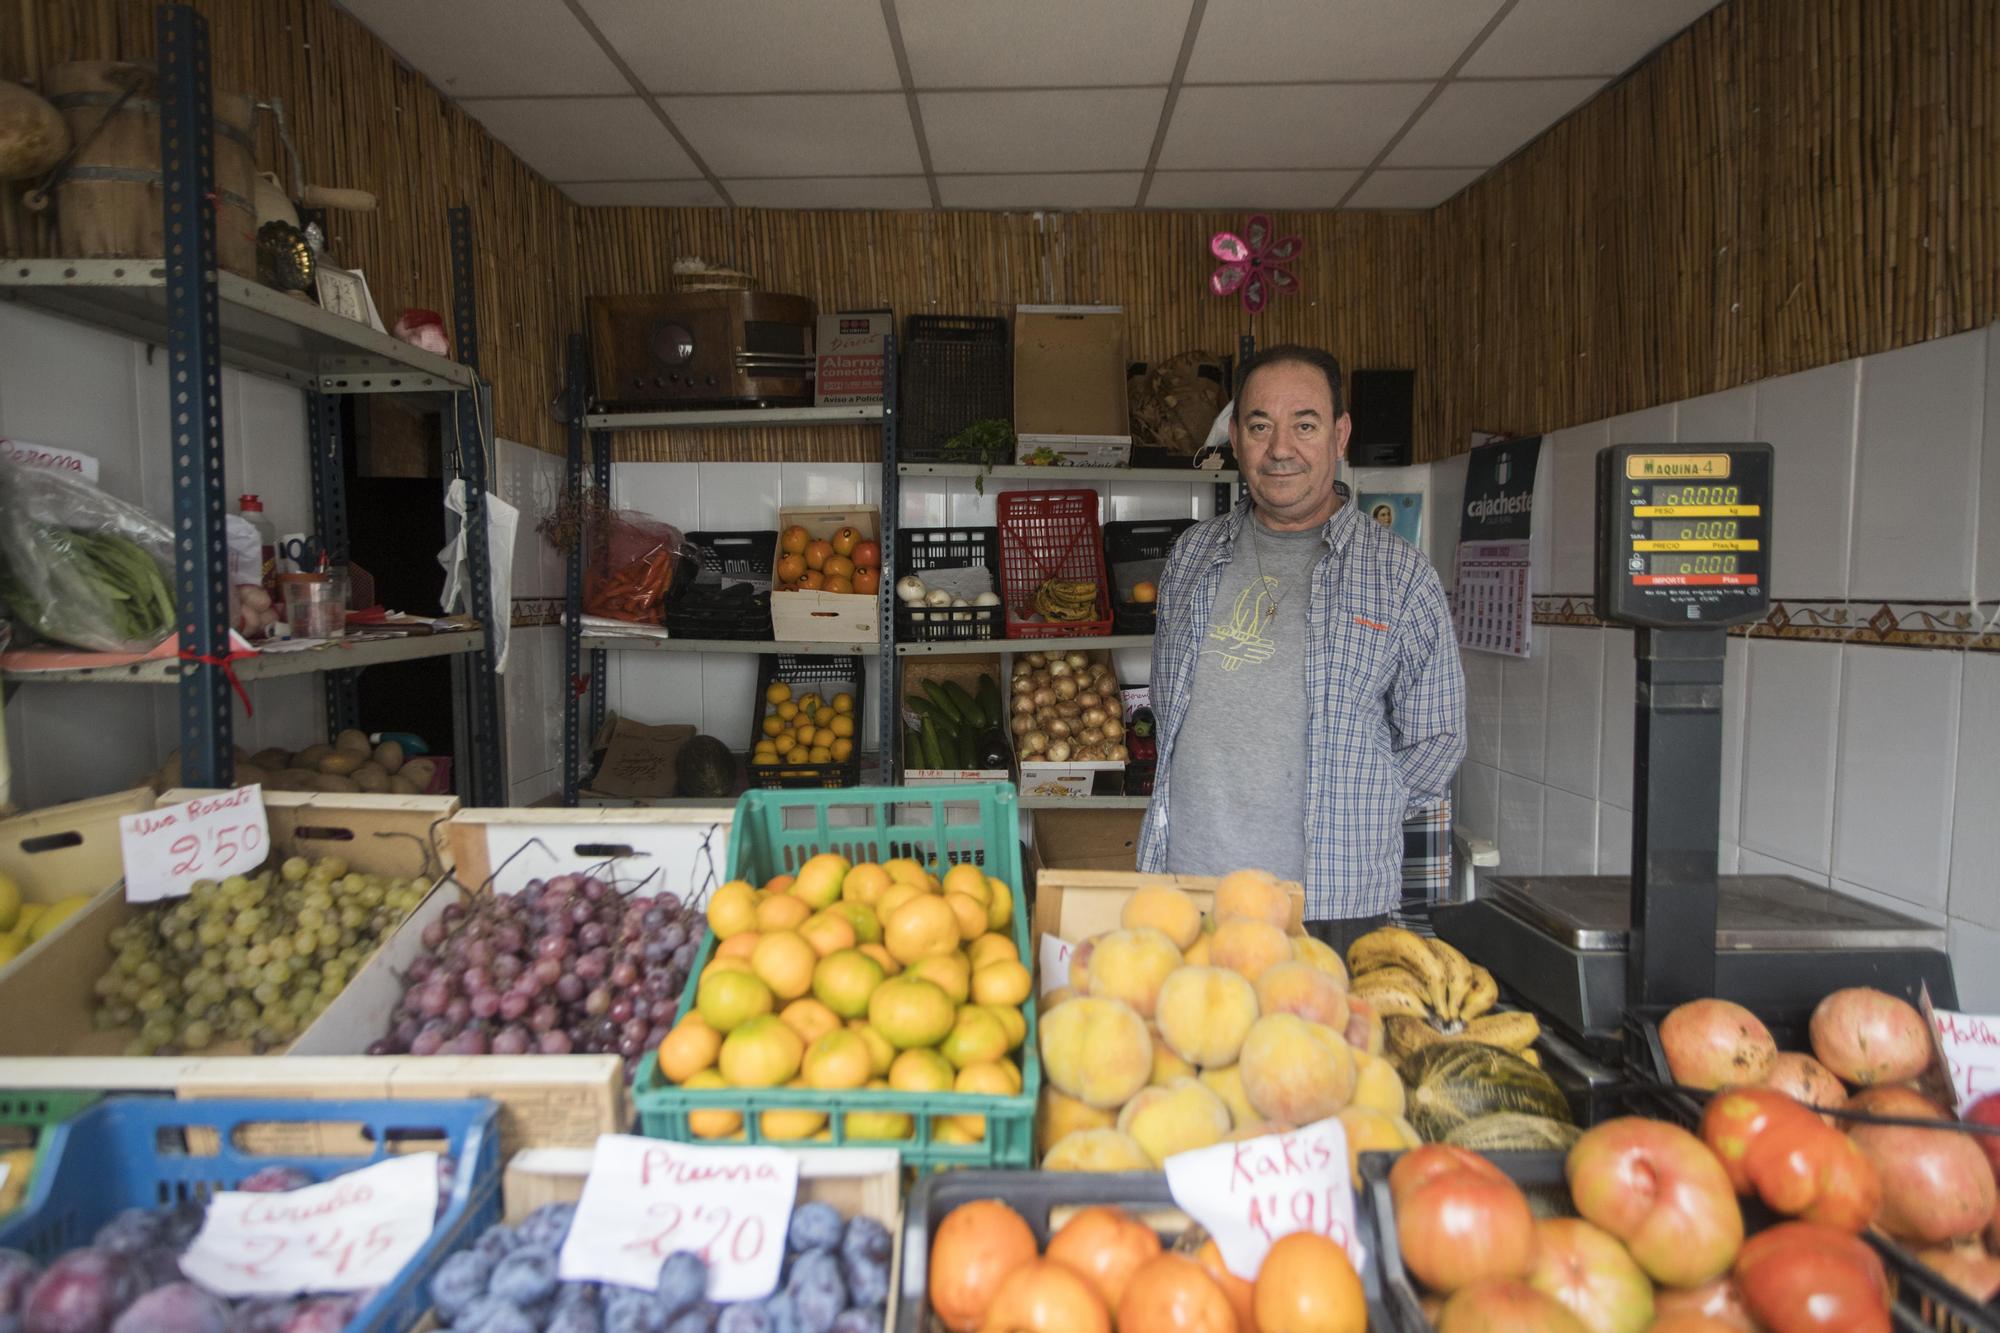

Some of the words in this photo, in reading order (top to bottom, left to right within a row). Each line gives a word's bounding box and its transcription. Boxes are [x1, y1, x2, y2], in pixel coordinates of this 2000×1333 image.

[1654, 507, 1675, 515] PESO
[1729, 508, 1739, 516] kg
[1652, 542, 1681, 550] PRECIO
[1652, 576, 1687, 585] IMPORTE
